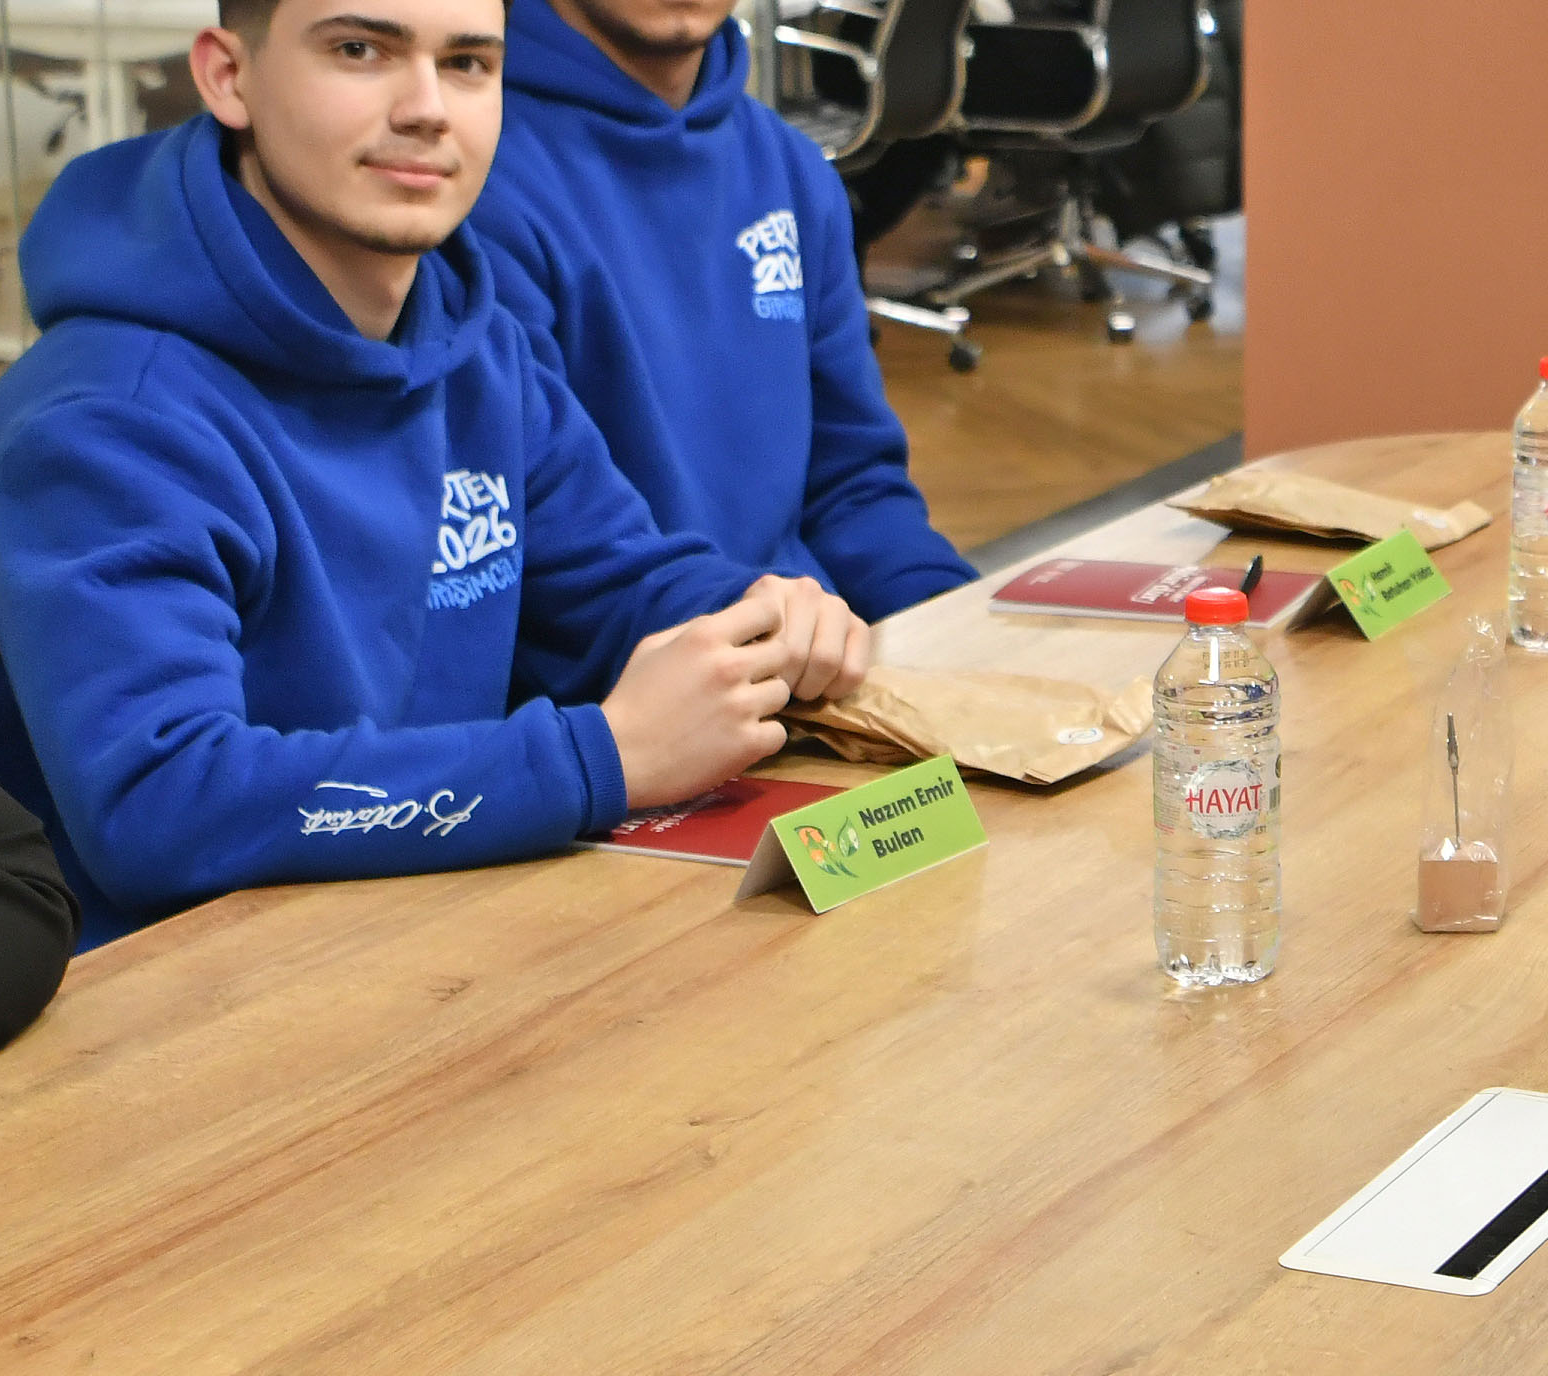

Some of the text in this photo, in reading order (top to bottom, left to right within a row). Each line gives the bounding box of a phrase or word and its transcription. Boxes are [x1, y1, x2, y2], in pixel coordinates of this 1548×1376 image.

[858, 775, 954, 830] Nazım Emir
[1185, 783, 1263, 814] HAYAT
[872, 825, 925, 859] Bulan
